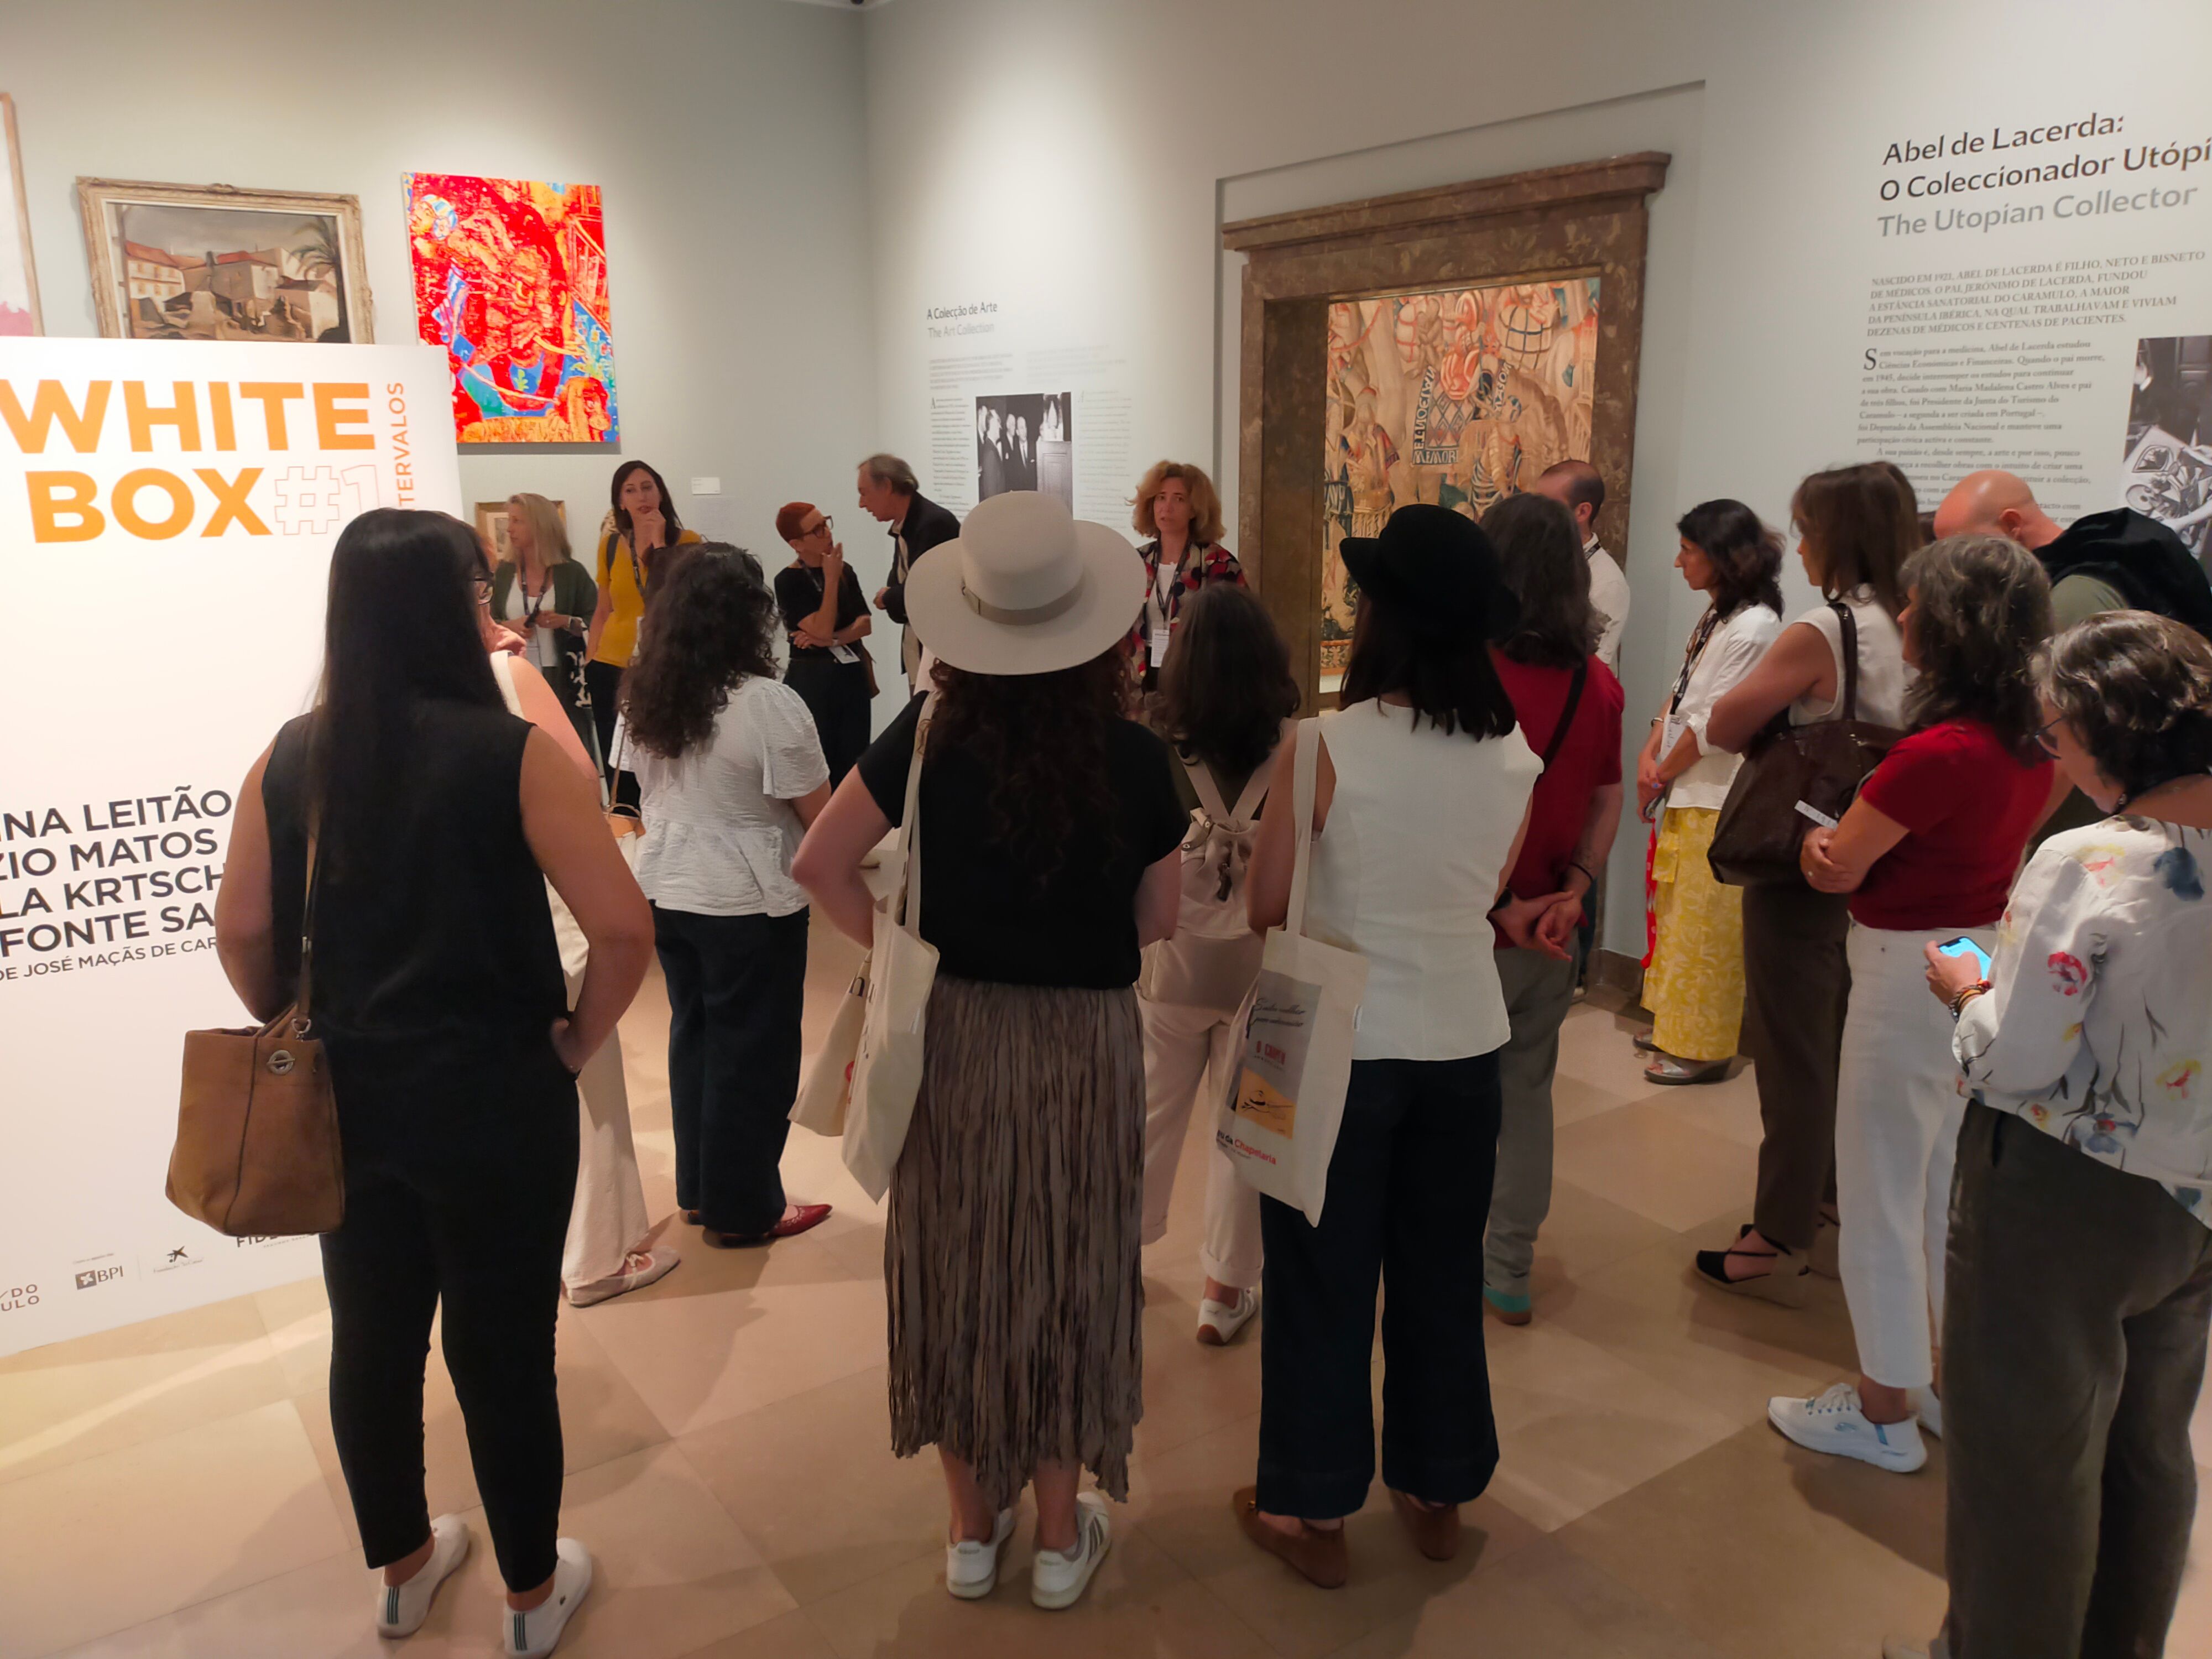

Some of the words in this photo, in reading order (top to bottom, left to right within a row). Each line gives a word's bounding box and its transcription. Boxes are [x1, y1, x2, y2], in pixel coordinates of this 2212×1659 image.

[1882, 134, 1945, 165] Abel
[1951, 131, 1984, 156] de
[1992, 112, 2124, 150] Lacerda:
[1880, 179, 1900, 201] O
[1907, 154, 2115, 197] Coleccionador
[1877, 212, 1927, 237] The
[1935, 202, 2044, 233] Utopian
[2053, 186, 2198, 218] Collector
[1871, 275, 1914, 286] NASCIDO
[1917, 273, 1932, 283] EM
[1957, 269, 1983, 280] ABEL
[1985, 268, 2000, 278] DE
[2002, 262, 2052, 276] LACERDA
[2055, 261, 2063, 272] É
[2064, 260, 2102, 271] FILHO,
[2105, 256, 2138, 267] NETO
[2141, 255, 2149, 265] E
[2151, 251, 2205, 264] BISNETO
[1870, 290, 1885, 299] DE
[1935, 286, 1943, 294] O
[1964, 279, 2020, 294] JERÓNIMO
[2022, 278, 2037, 288] DE
[2039, 274, 2095, 288] LACERDA,
[2098, 270, 2147, 283] FUNDOU
[927, 309, 933, 320] A
[934, 305, 967, 320] Colecção
[969, 304, 978, 315] de
[980, 301, 998, 314] Arte
[1868, 315, 1882, 324] DA
[1883, 311, 1936, 323] PENÍNSULA
[1939, 309, 1981, 320] IBÉRICA,
[1985, 307, 1999, 316] NA
[2001, 305, 2030, 317] QUAL
[2034, 300, 2119, 315] TRABALHAVAM
[2122, 300, 2129, 309] E
[2132, 296, 2177, 307] VIVIAM
[1869, 303, 1877, 312] A
[1878, 299, 1925, 311] ESTÂNCIA
[1927, 295, 1991, 308] SANATORIAL
[1994, 294, 2010, 303] DO
[2012, 289, 2077, 301] CARAMULO,
[2080, 288, 2088, 297] A
[2090, 285, 2130, 296] MAIOR
[927, 327, 942, 338] The
[943, 326, 956, 336] Art
[957, 324, 994, 335] Collection
[1867, 327, 1911, 337] DEZENAS
[1912, 326, 1926, 334] DE
[1928, 322, 1975, 333] MÉDICOS
[1976, 322, 1984, 331] E
[1985, 318, 2042, 331] CENTENAS
[2044, 318, 2059, 327] DE
[2062, 314, 2126, 327] PACIENTES.
[1989, 343, 2008, 352] Abel
[2022, 341, 2054, 351] Lacerda
[2057, 340, 2091, 349] estudou
[1981, 370, 2011, 378] estudos
[2013, 371, 2031, 379] para
[2033, 368, 2074, 377] continuar
[2017, 355, 2051, 366] Quando
[2060, 354, 2074, 365] pai
[1998, 396, 2008, 404] do
[2011, 395, 2046, 404] Turismo
[2048, 395, 2059, 403] do
[2078, 382, 2092, 392] pai
[0, 379, 376, 453] WHITE
[2000, 409, 2036, 419] Portugal
[387, 383, 415, 507] TERVALOS
[2018, 450, 2032, 458] por
[2054, 450, 2080, 458] pouco
[0, 808, 72, 841] NA
[83, 785, 232, 831] LEITÃO
[70, 828, 217, 871] MATOS
[0, 910, 150, 958] FONTE
[160, 902, 215, 933] SA
[24, 956, 74, 977] JOSÉ
[78, 946, 146, 969] MAÇÃS
[152, 942, 176, 957] DE
[97, 1265, 123, 1282] BPI
[11, 1284, 38, 1298] DO
